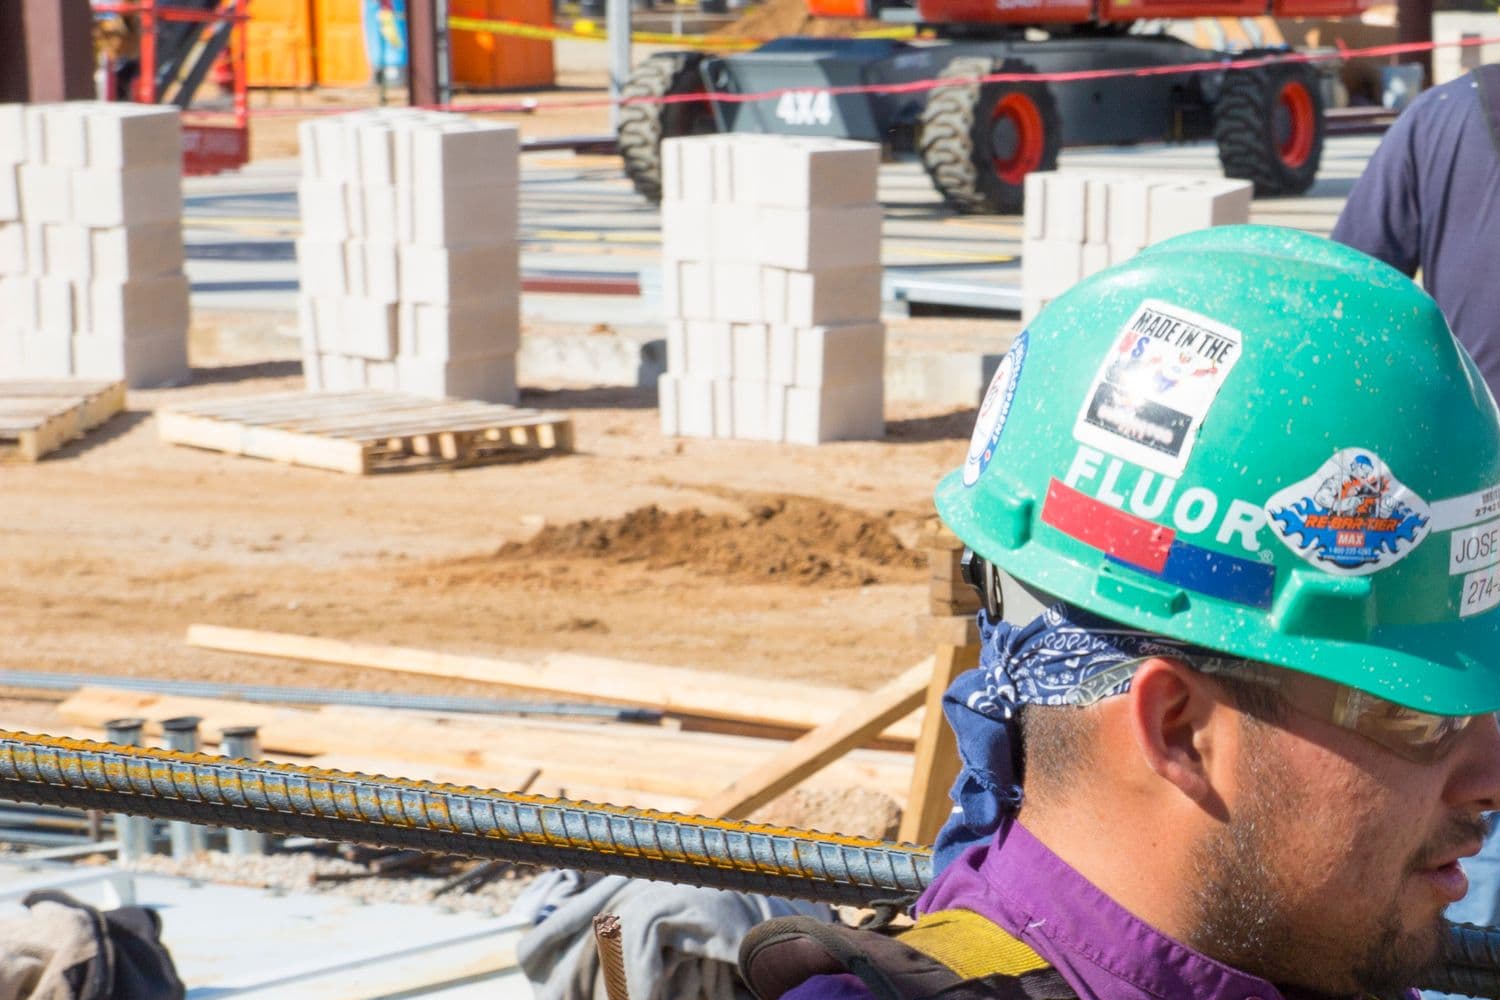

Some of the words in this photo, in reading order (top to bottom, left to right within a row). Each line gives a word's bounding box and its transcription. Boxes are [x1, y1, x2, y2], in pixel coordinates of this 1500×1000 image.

[1131, 311, 1181, 342] MADE
[1175, 327, 1200, 348] IN
[1196, 333, 1236, 365] THE
[1063, 444, 1267, 552] FLUOR
[1337, 532, 1365, 546] MAX
[1455, 529, 1499, 564] JOSE
